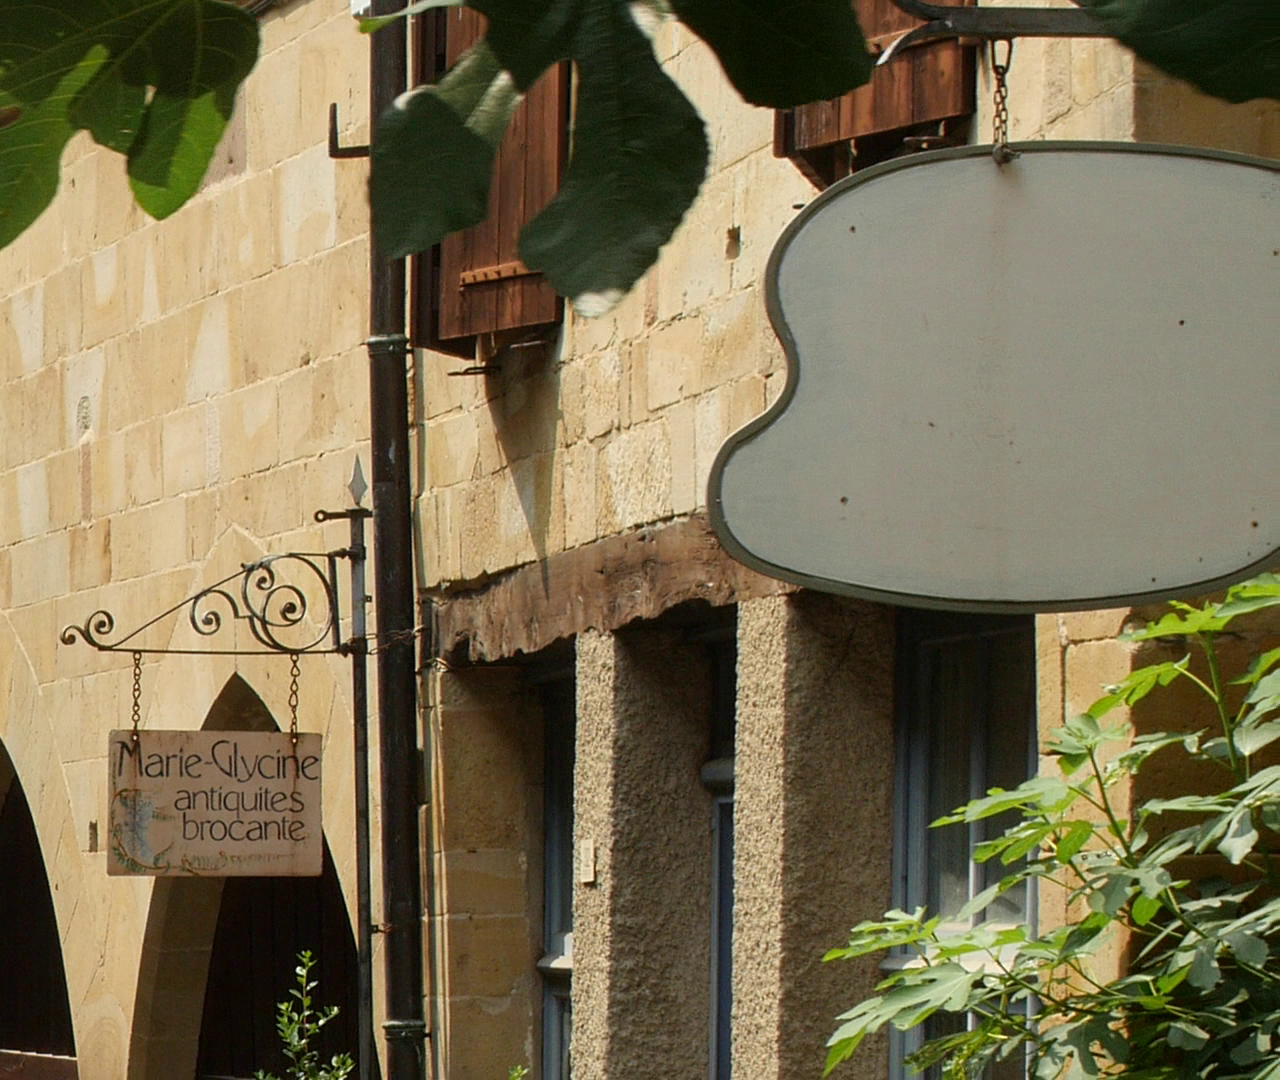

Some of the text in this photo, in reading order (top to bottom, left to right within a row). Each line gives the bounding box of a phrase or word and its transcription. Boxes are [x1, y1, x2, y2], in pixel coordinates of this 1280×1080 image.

[115, 740, 320, 783] Marie-Glycine
[173, 786, 305, 819] antiquites
[182, 811, 306, 842] brocante
